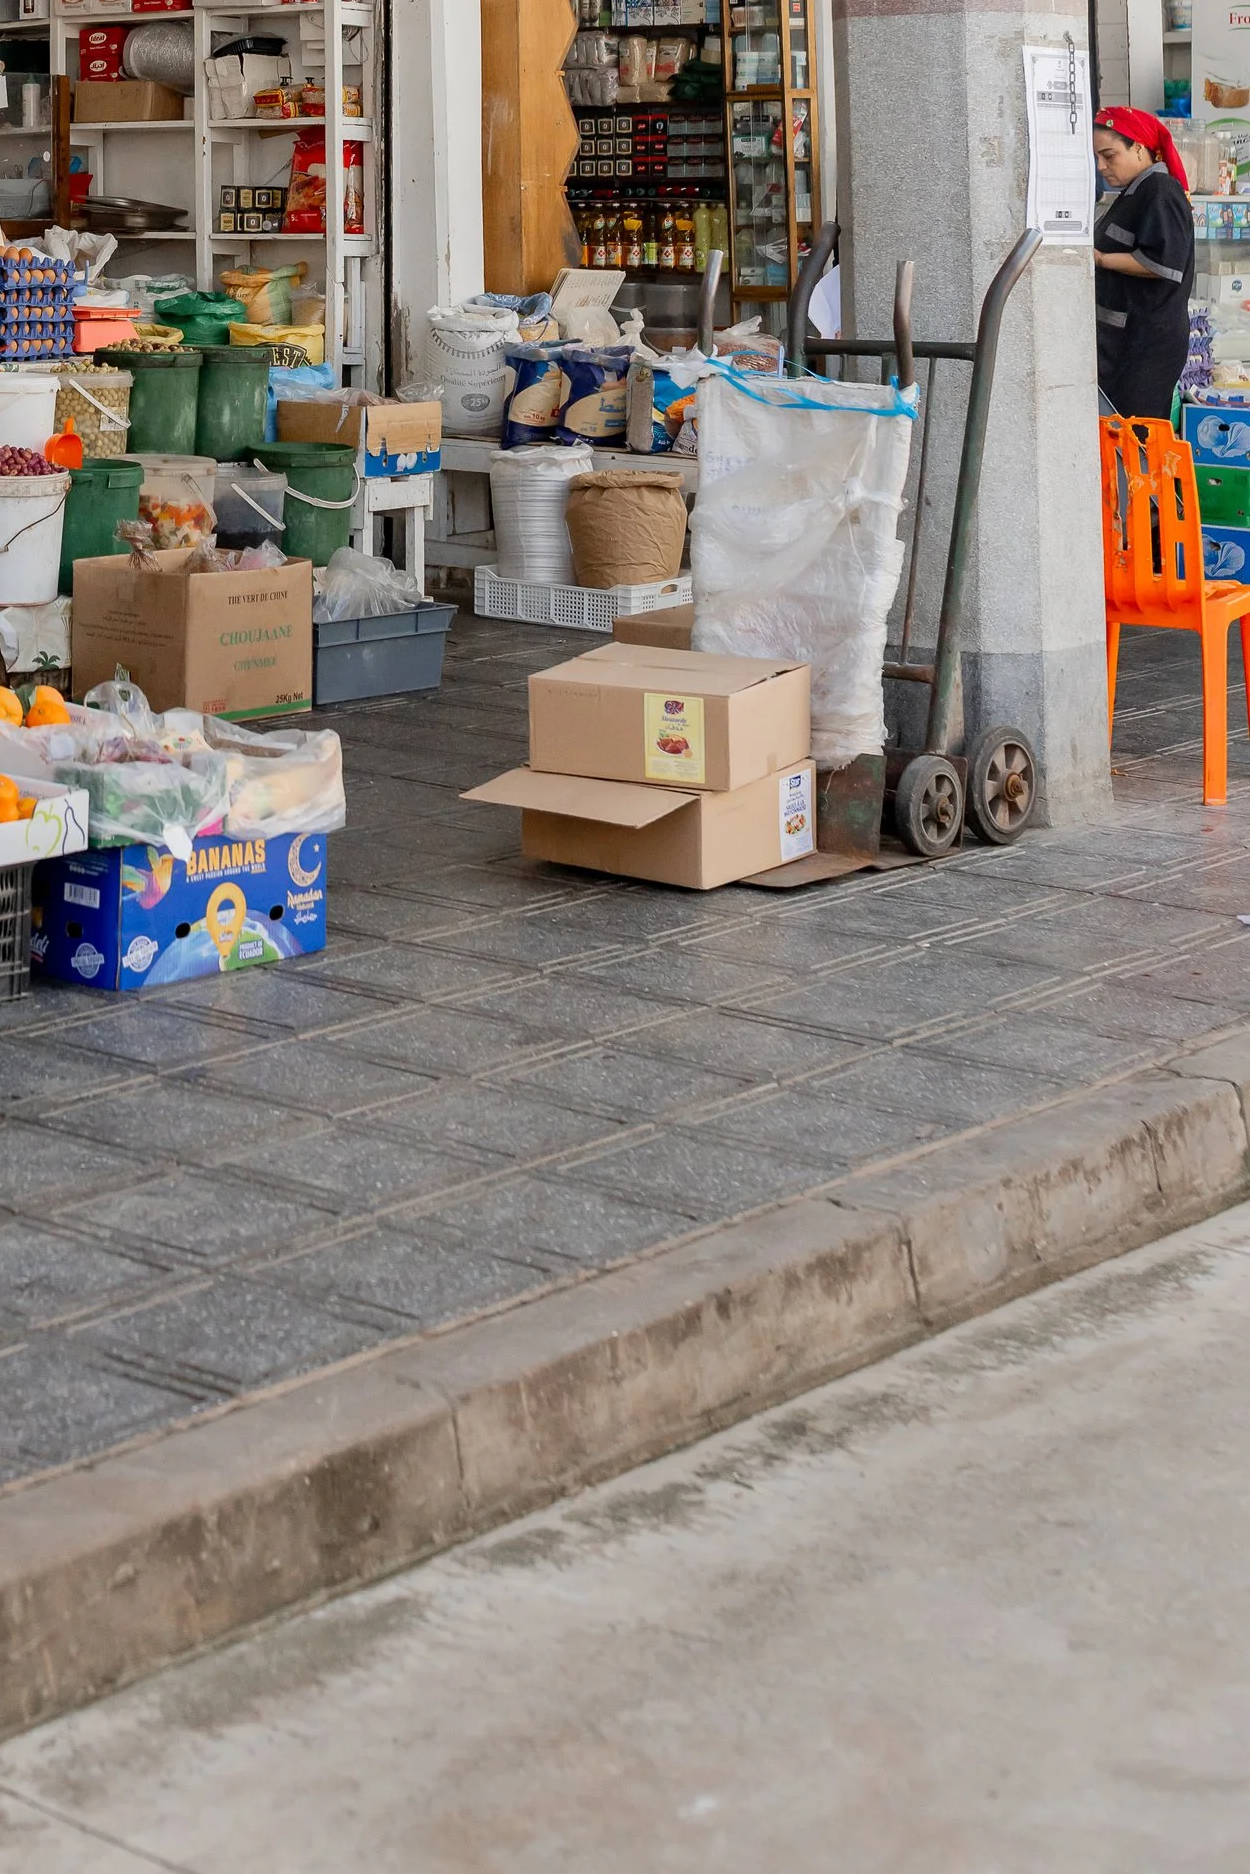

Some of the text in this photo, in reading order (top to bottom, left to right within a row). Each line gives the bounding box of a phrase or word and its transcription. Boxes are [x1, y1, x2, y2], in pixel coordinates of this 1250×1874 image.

[1230, 13, 1250, 24] Fro
[220, 624, 293, 648] CHOUJAANE
[276, 692, 304, 705] 25Kg Net
[186, 838, 266, 877] BANANAS
[287, 888, 323, 909] Ramadan
[240, 946, 263, 960] ECUADOR
